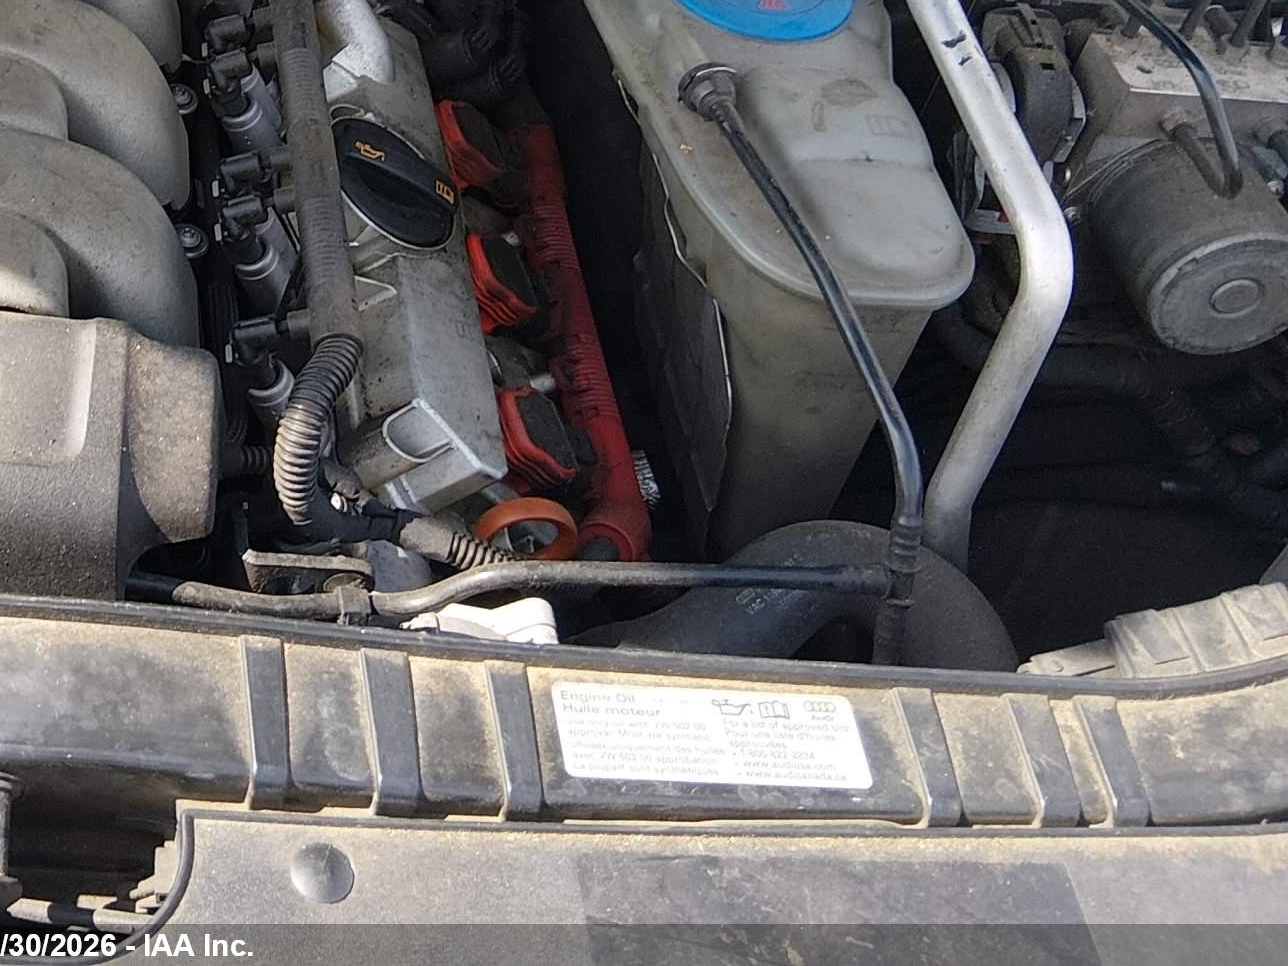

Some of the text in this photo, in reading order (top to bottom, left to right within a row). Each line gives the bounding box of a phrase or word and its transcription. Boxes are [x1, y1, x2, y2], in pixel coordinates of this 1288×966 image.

[560, 689, 636, 704] Engine Oil
[563, 702, 661, 717] Huile moteur
[673, 722, 690, 730] 502
[723, 718, 739, 727] For
[751, 720, 766, 728] list
[768, 720, 779, 729] of
[782, 722, 829, 732] approved
